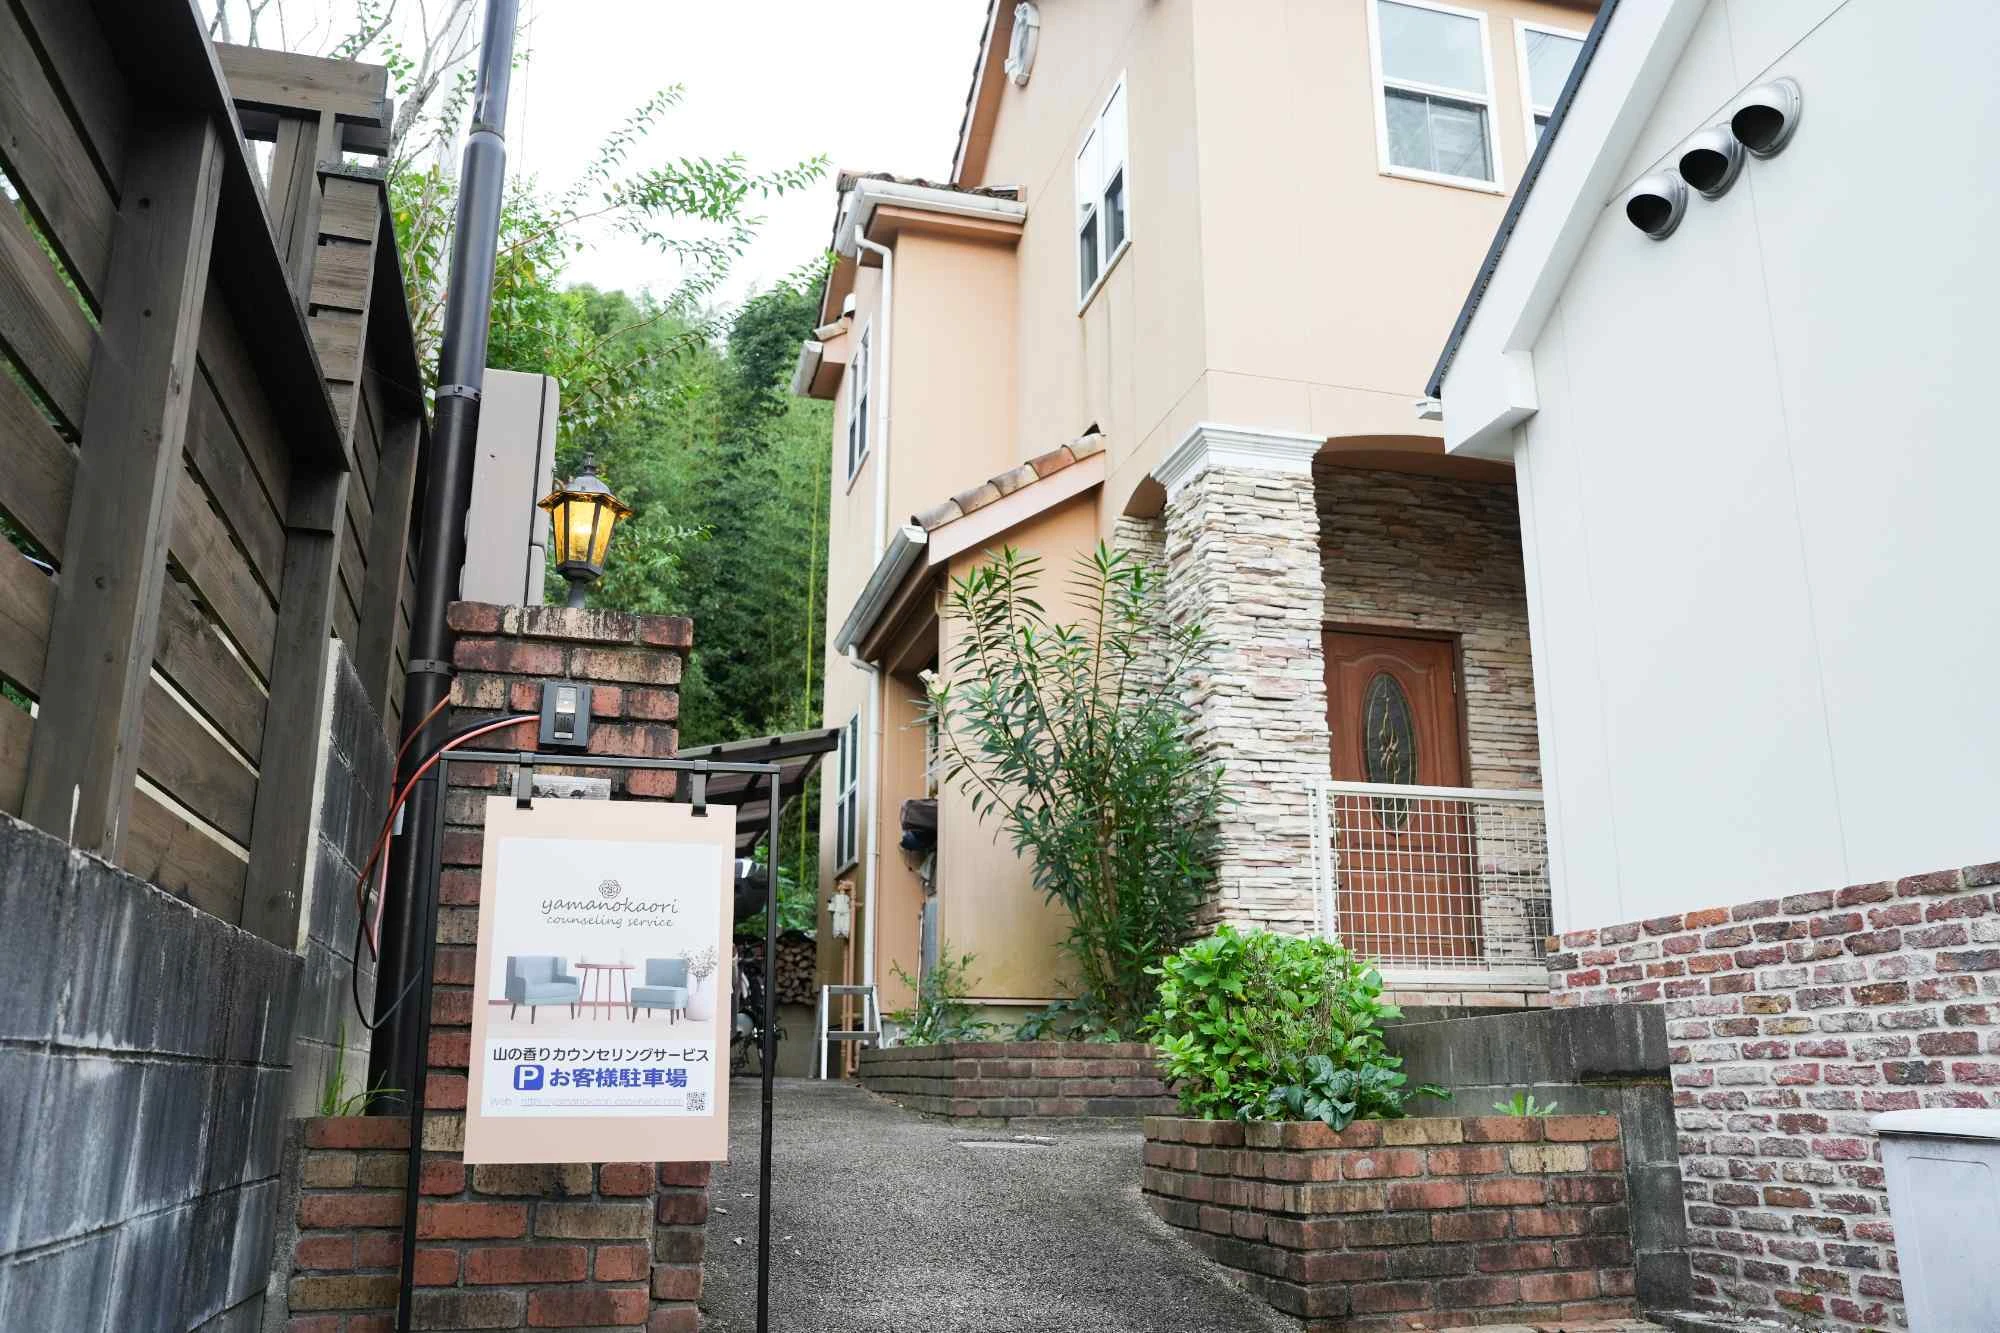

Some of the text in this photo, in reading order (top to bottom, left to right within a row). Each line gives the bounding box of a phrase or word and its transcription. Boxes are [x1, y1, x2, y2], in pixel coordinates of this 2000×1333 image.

[542, 897, 679, 915] yamanokaori
[546, 915, 673, 928] counseling service
[493, 1047, 709, 1062] 山の香りカウンセリングサービス
[517, 1066, 688, 1089] P お客様駐車場
